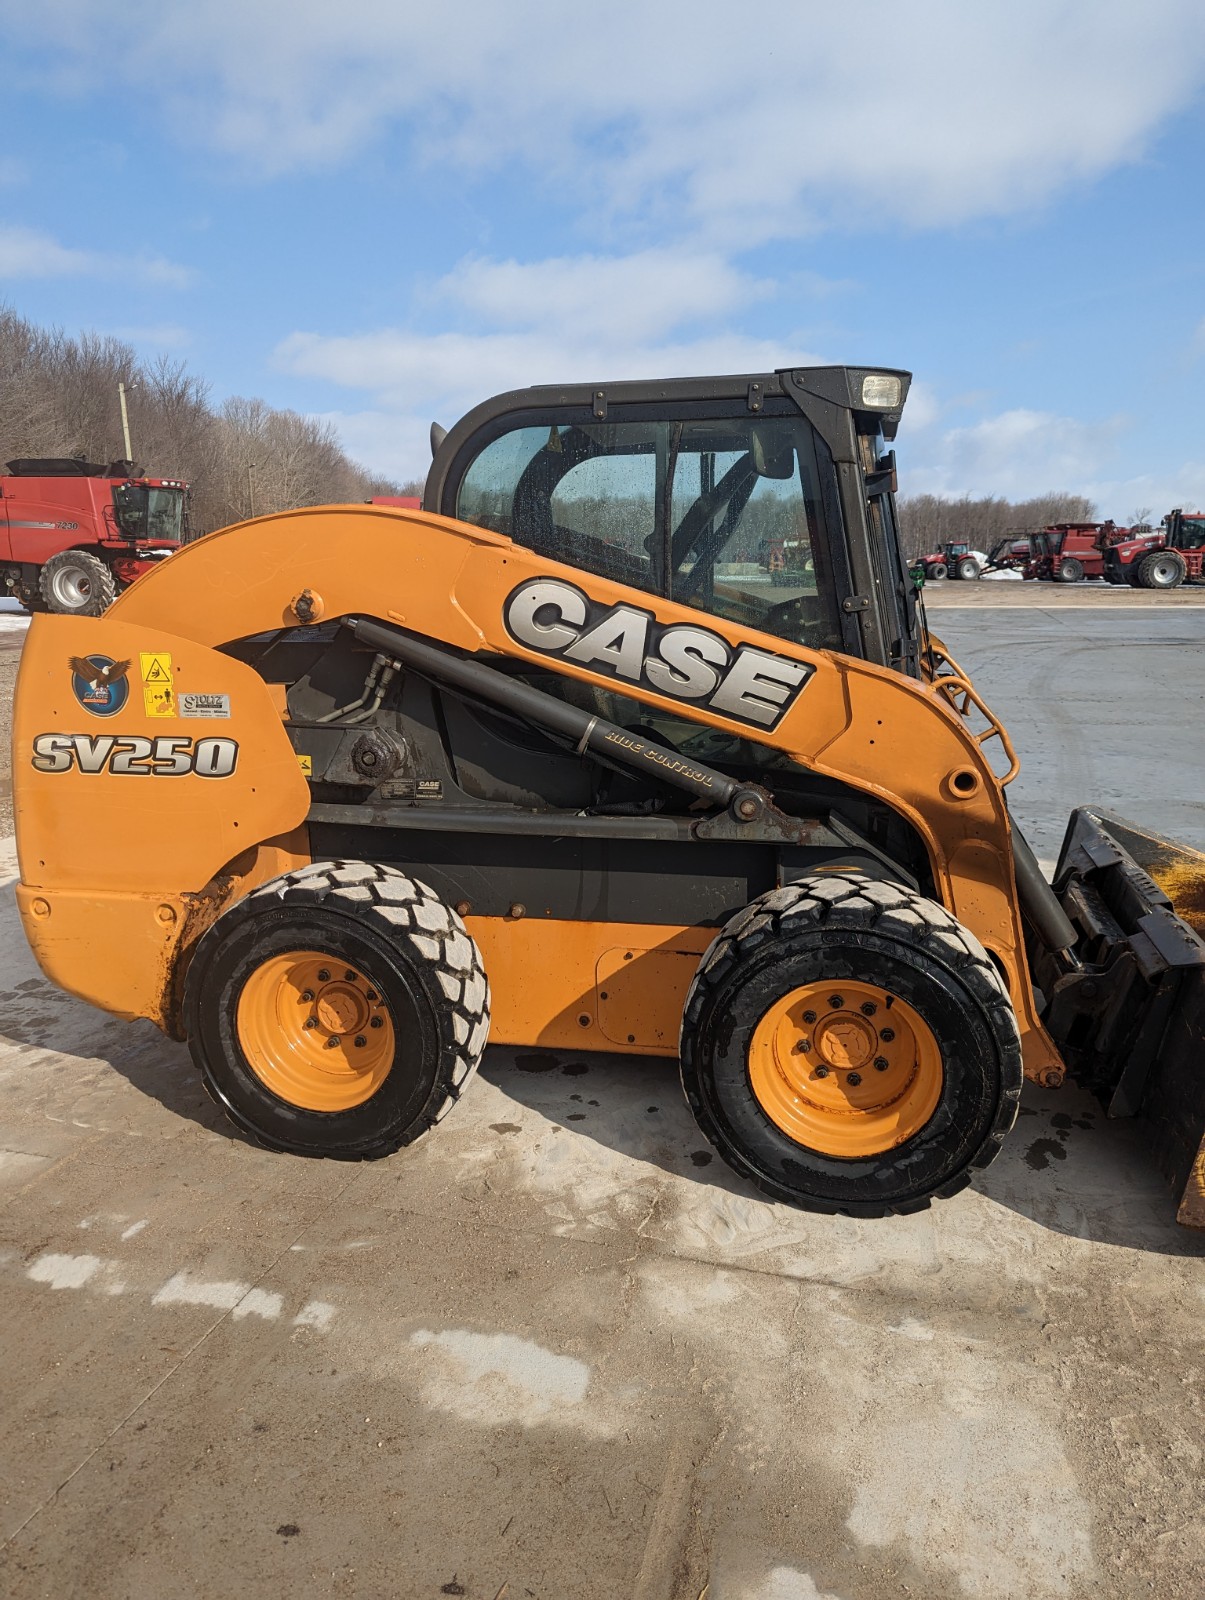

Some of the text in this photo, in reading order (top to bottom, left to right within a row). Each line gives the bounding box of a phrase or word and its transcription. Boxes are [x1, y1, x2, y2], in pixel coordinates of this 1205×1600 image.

[507, 581, 810, 728] CASE
[32, 733, 239, 777] SV250
[604, 730, 713, 787] RIDE CONTROL
